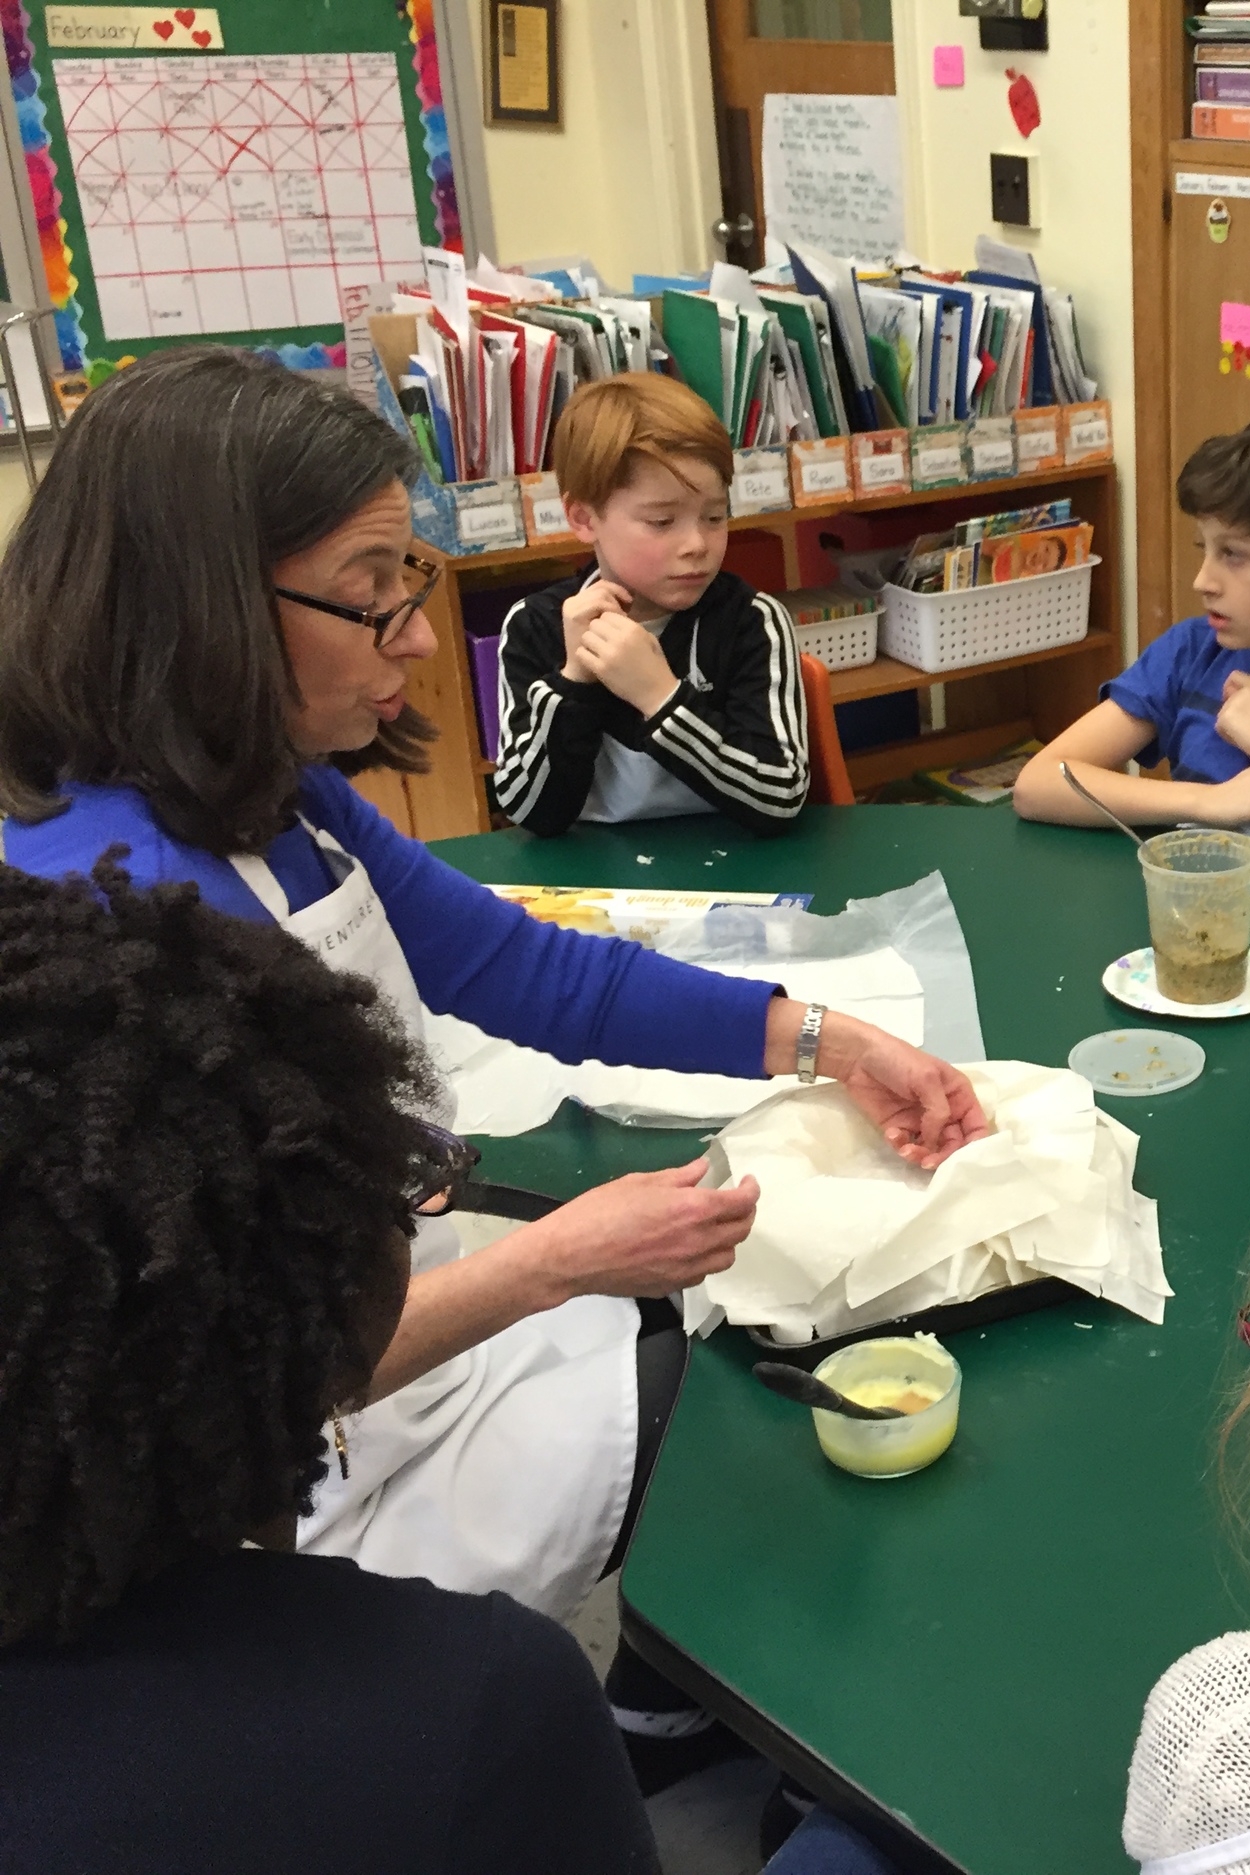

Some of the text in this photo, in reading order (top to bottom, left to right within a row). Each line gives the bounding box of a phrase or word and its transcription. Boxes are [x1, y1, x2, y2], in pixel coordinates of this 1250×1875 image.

[50, 15, 140, 48] February
[809, 470, 836, 488] Ryan
[744, 480, 773, 497] Pete
[625, 894, 710, 908] fillo dough
